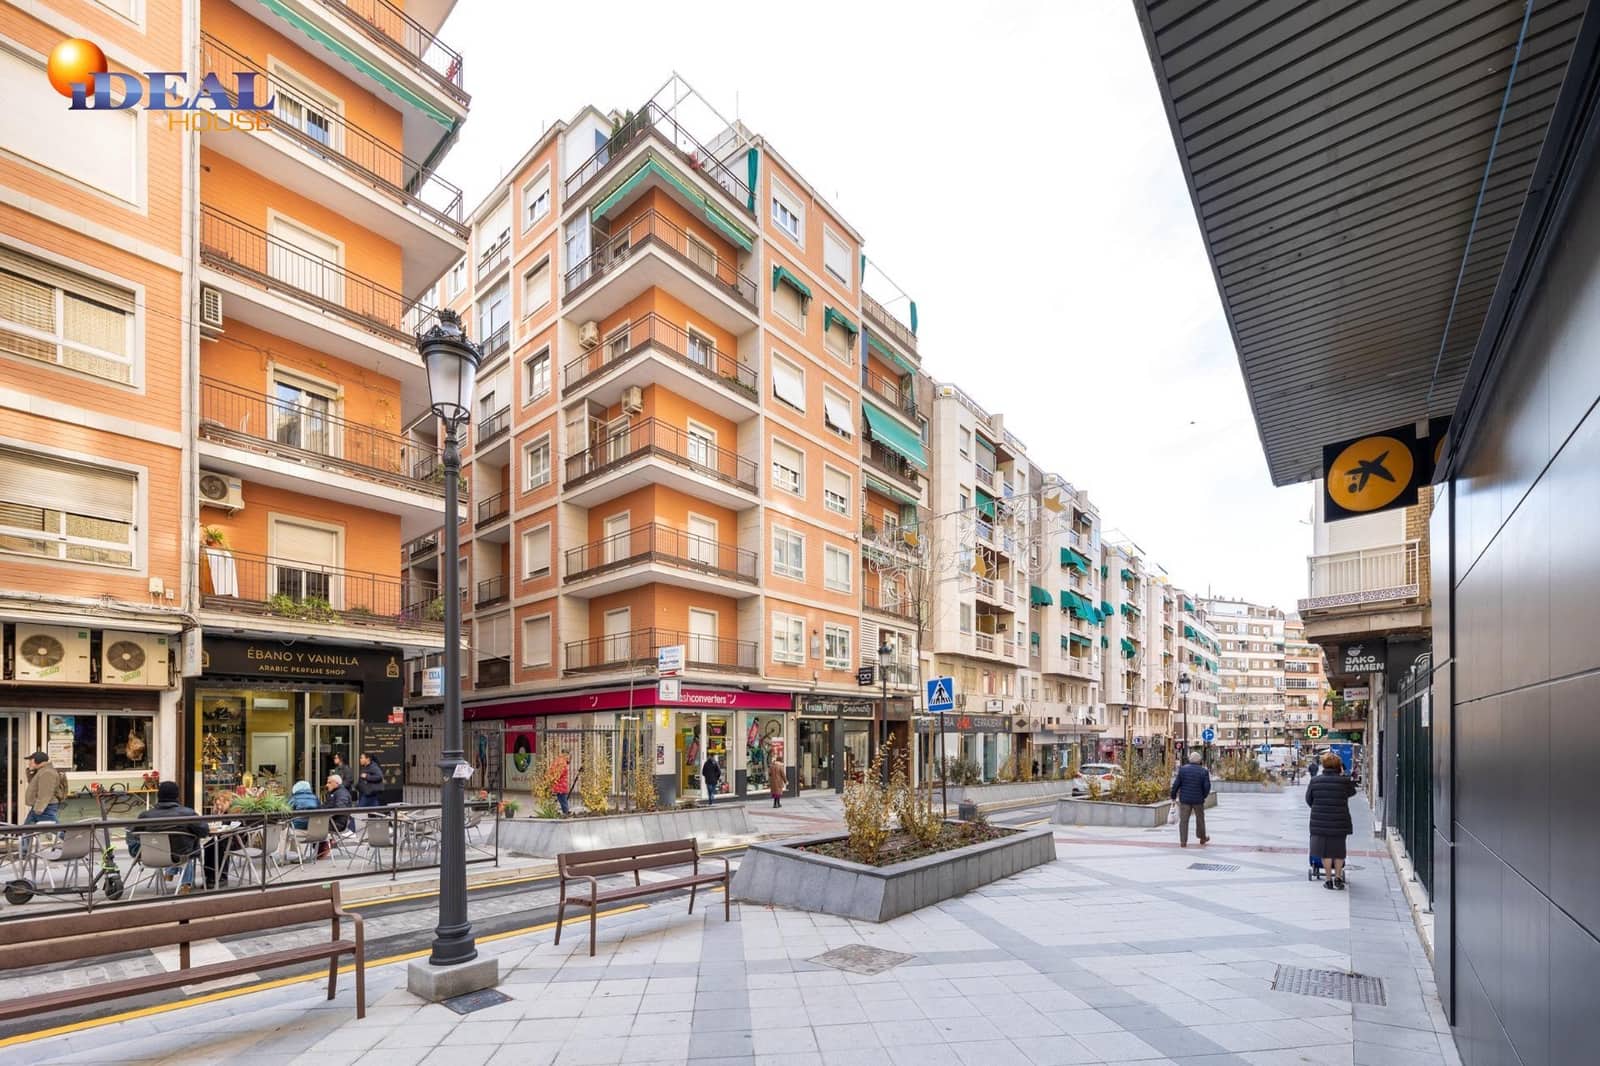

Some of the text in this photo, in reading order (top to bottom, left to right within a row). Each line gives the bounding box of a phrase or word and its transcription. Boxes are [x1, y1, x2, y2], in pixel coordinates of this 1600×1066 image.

[247, 646, 359, 666] ÉBANO Y VAINILLA
[1345, 655, 1376, 665] JAKO
[258, 664, 289, 673] ARABIC
[325, 668, 345, 676] SHOP
[1345, 663, 1384, 673] RAMEN
